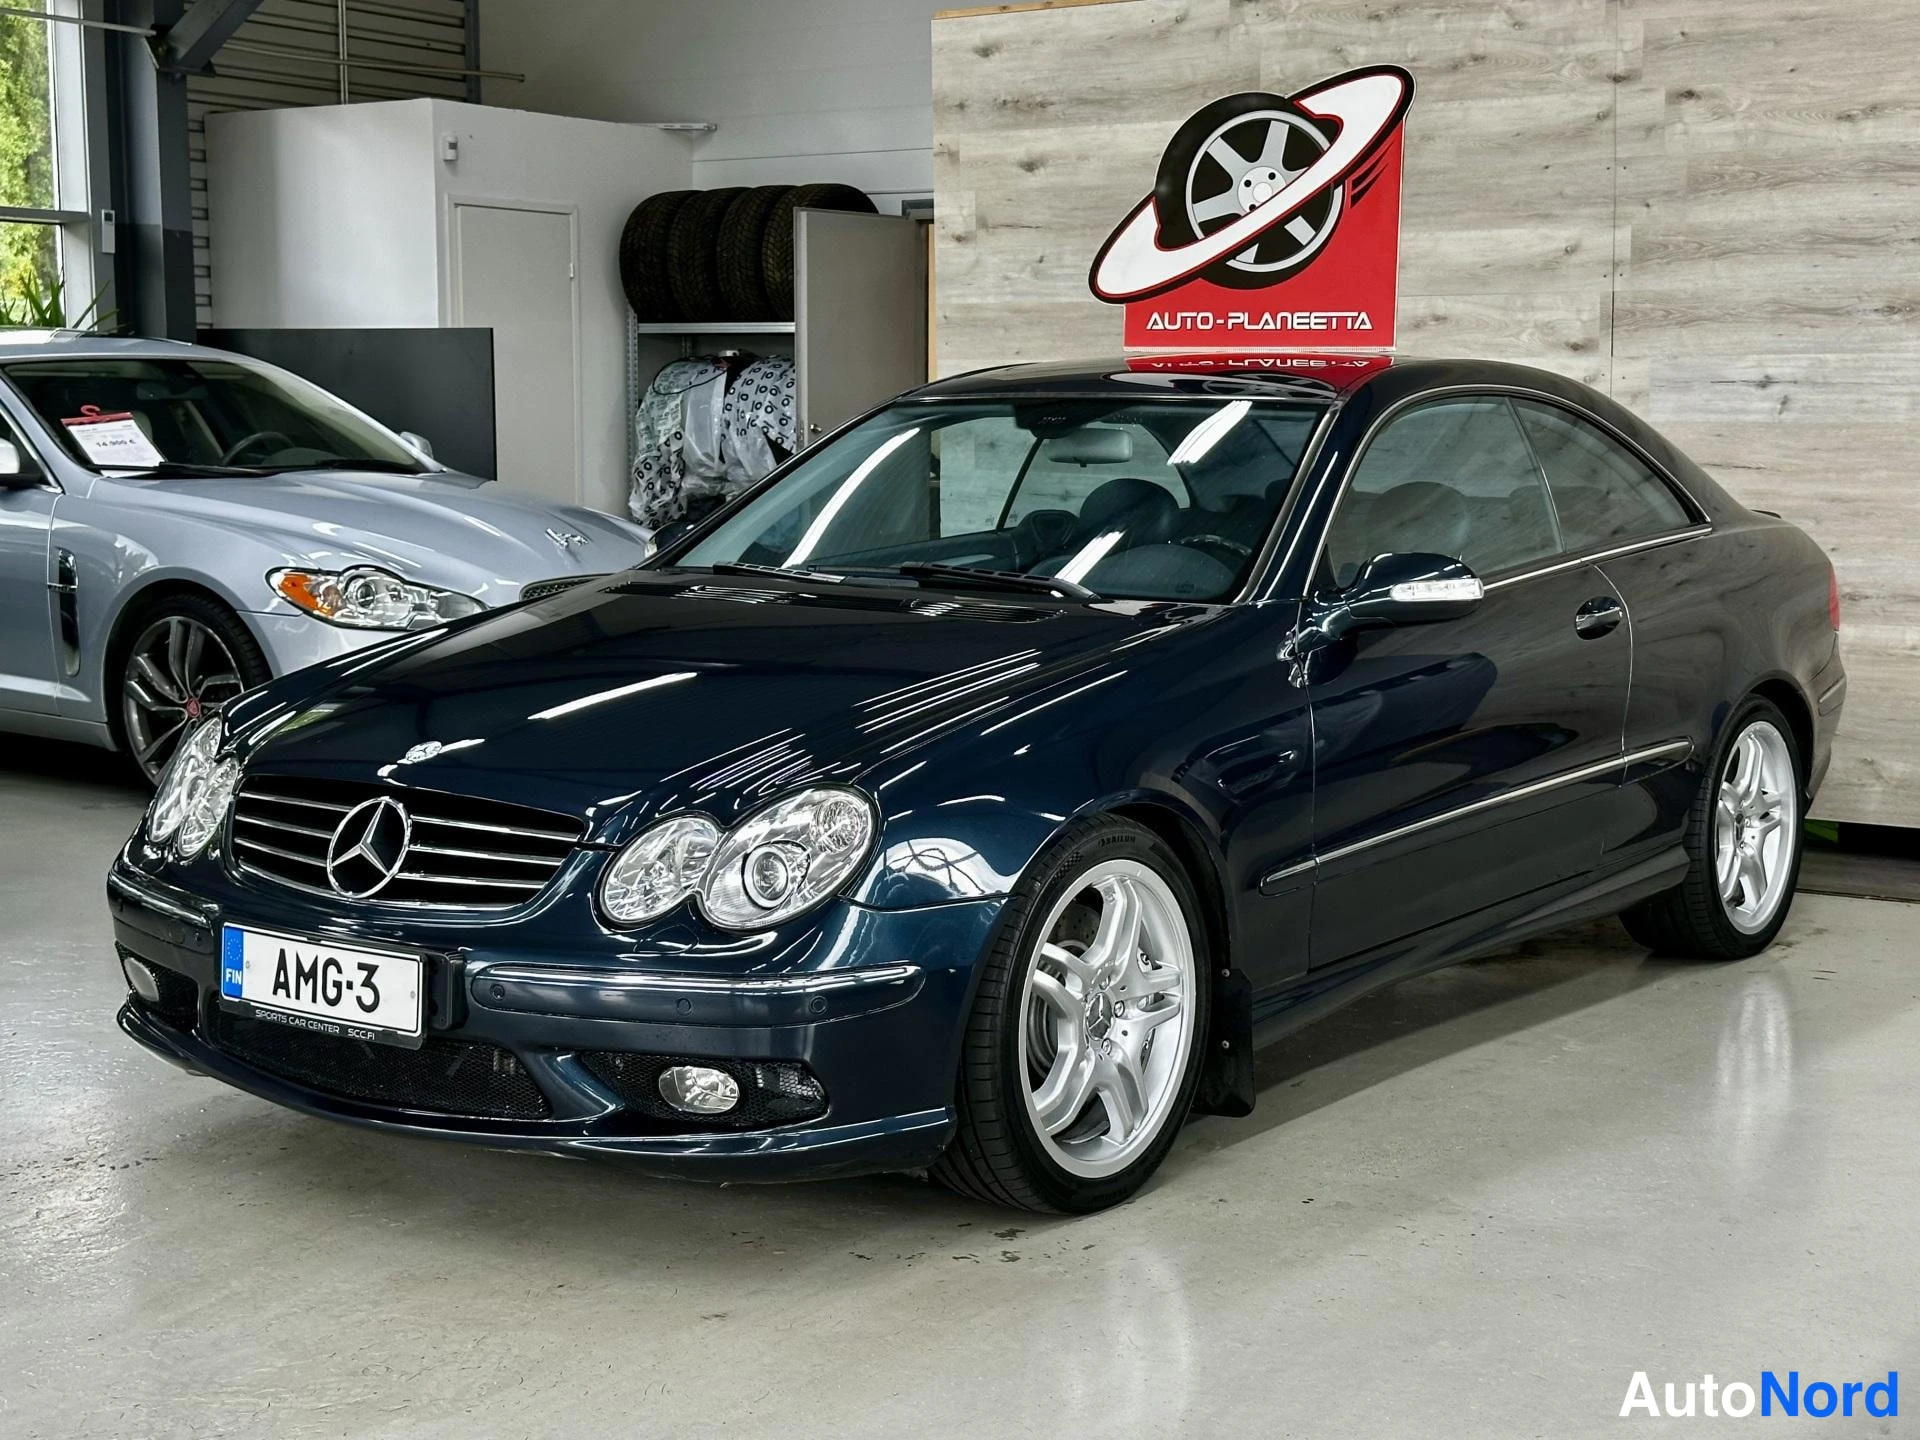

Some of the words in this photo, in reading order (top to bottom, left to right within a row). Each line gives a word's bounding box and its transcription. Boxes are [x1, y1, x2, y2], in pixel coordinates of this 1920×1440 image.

[1146, 311, 1373, 330] AUTO-PLANEETTA
[225, 968, 242, 985] FIN
[272, 948, 380, 1013] AMG-3
[255, 1009, 288, 1023] SPORTS
[288, 1016, 307, 1028] CAR
[307, 1020, 340, 1034] CENTER
